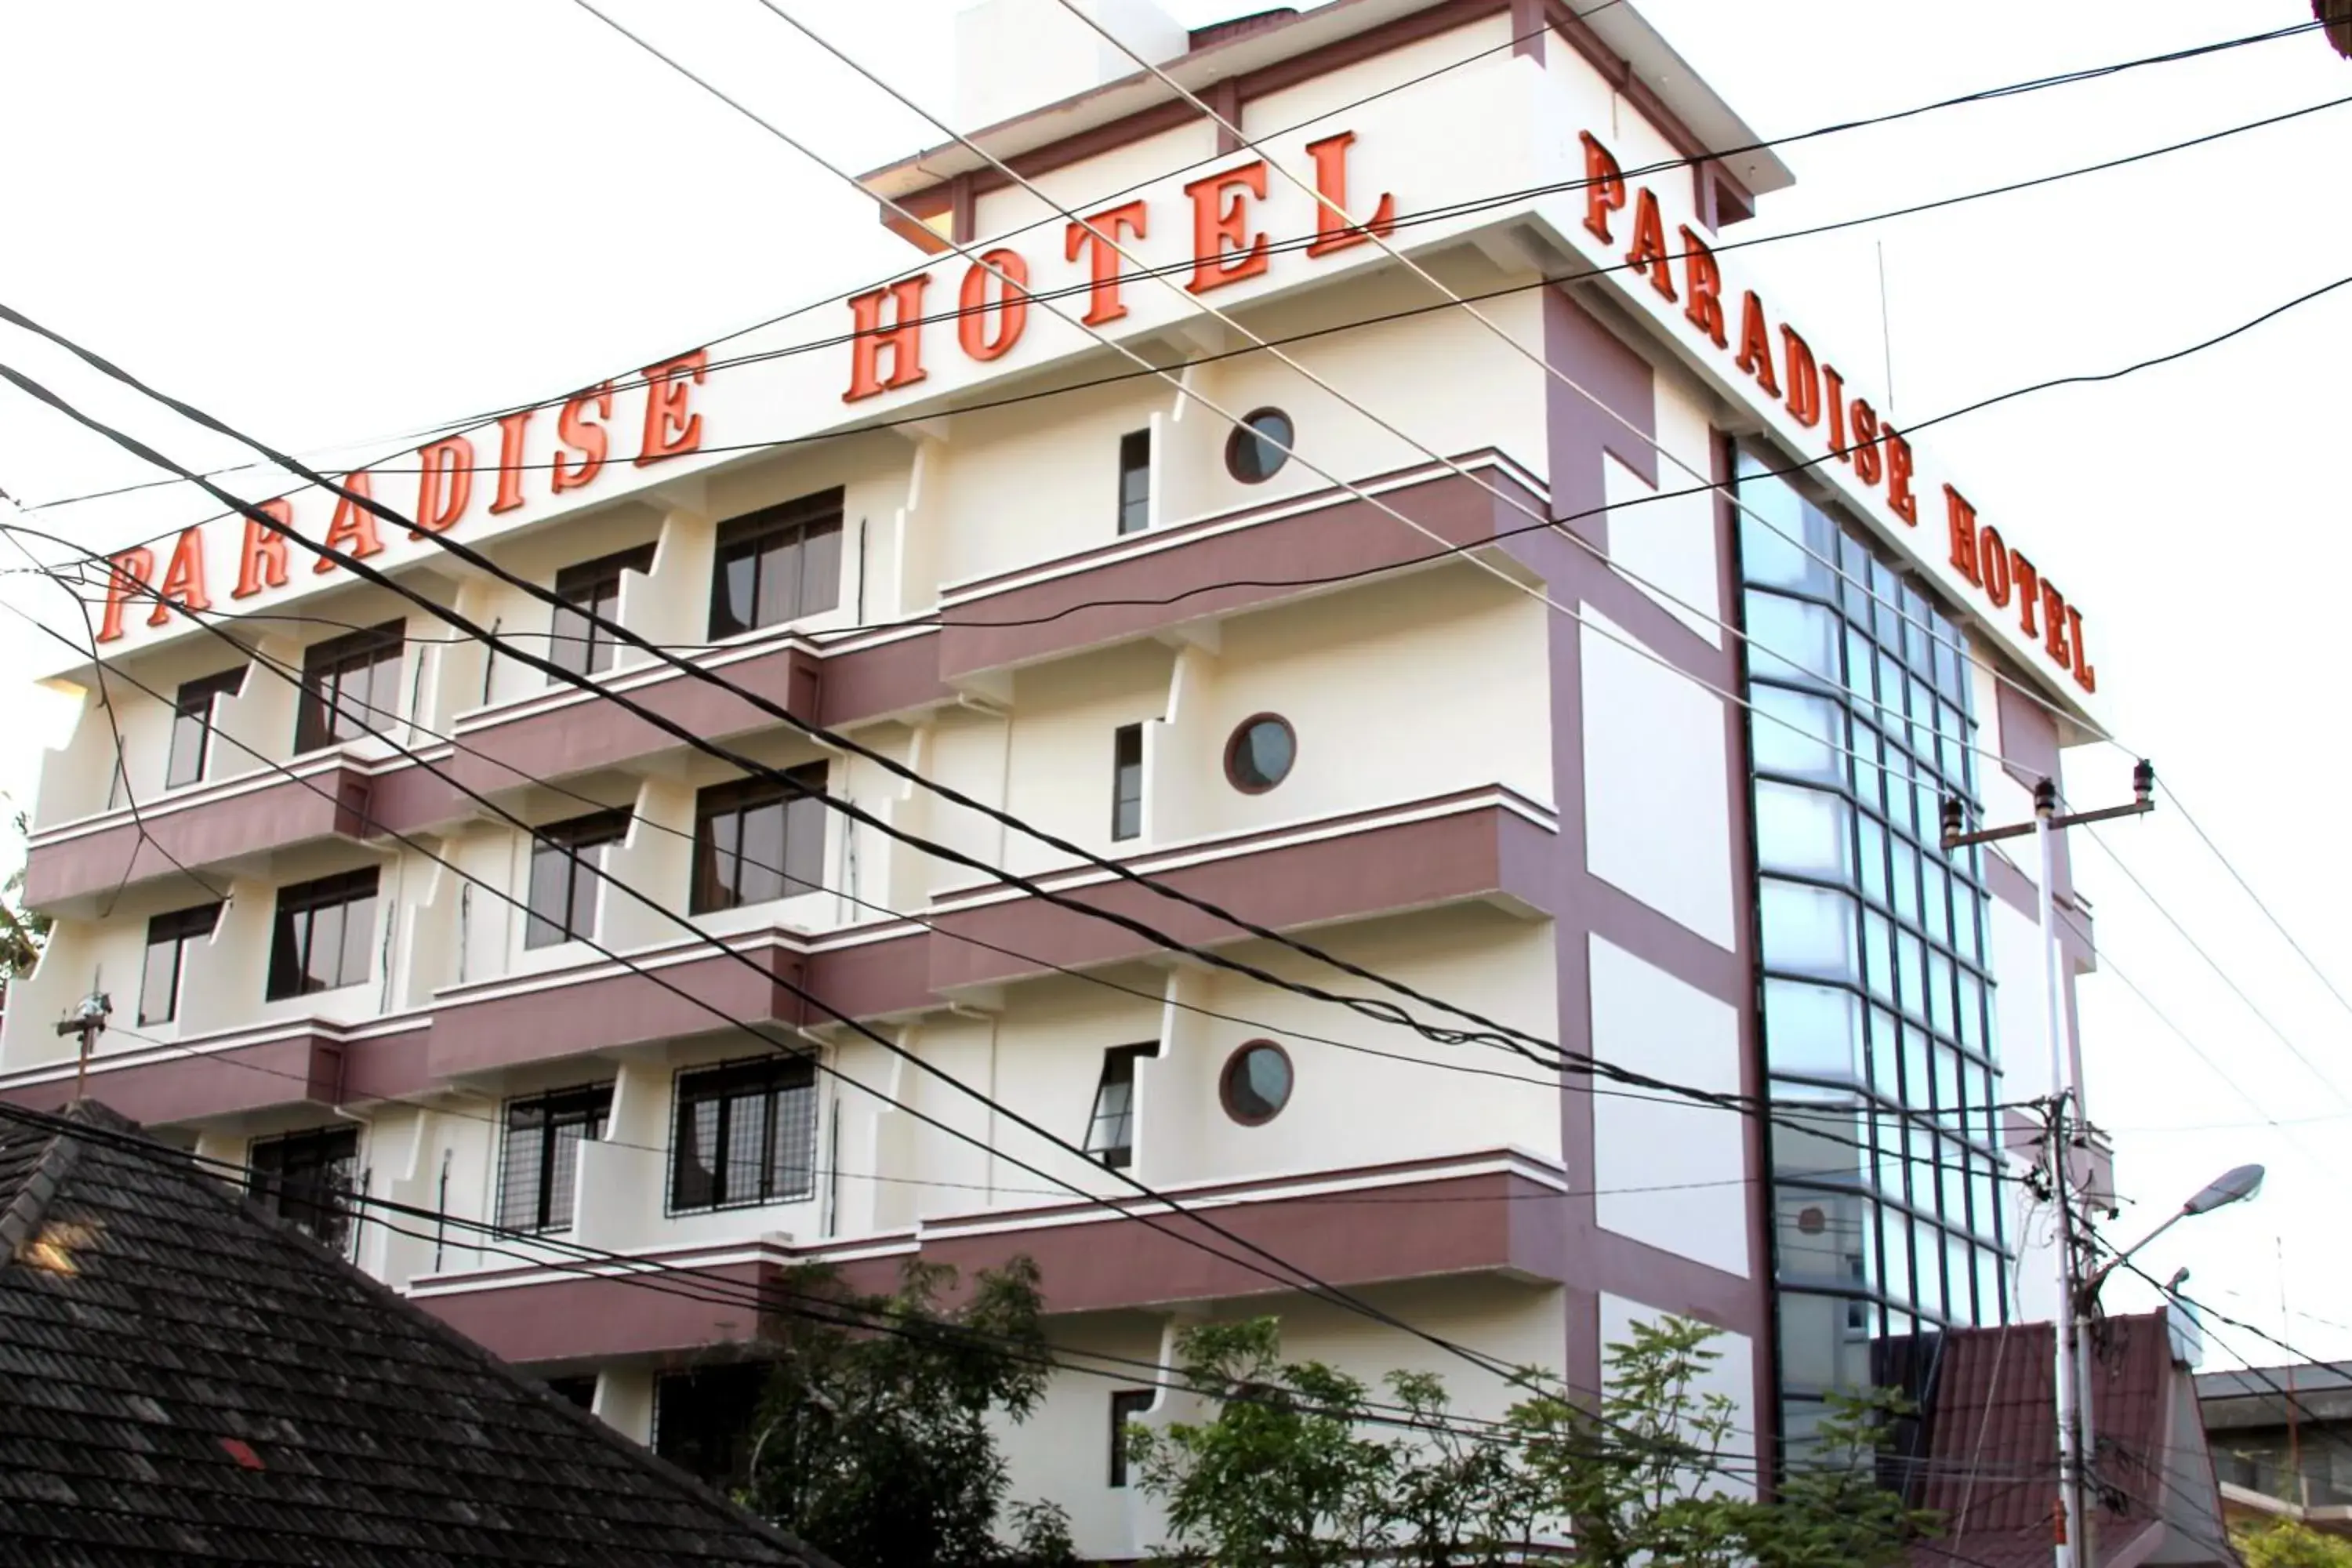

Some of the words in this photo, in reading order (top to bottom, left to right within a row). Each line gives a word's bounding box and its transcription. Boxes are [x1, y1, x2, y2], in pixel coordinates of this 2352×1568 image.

[96, 348, 709, 644] PARADISE
[841, 129, 1395, 405] HOTEL
[1579, 130, 1918, 527] PARADISE
[1944, 484, 2096, 694] HOTEL
